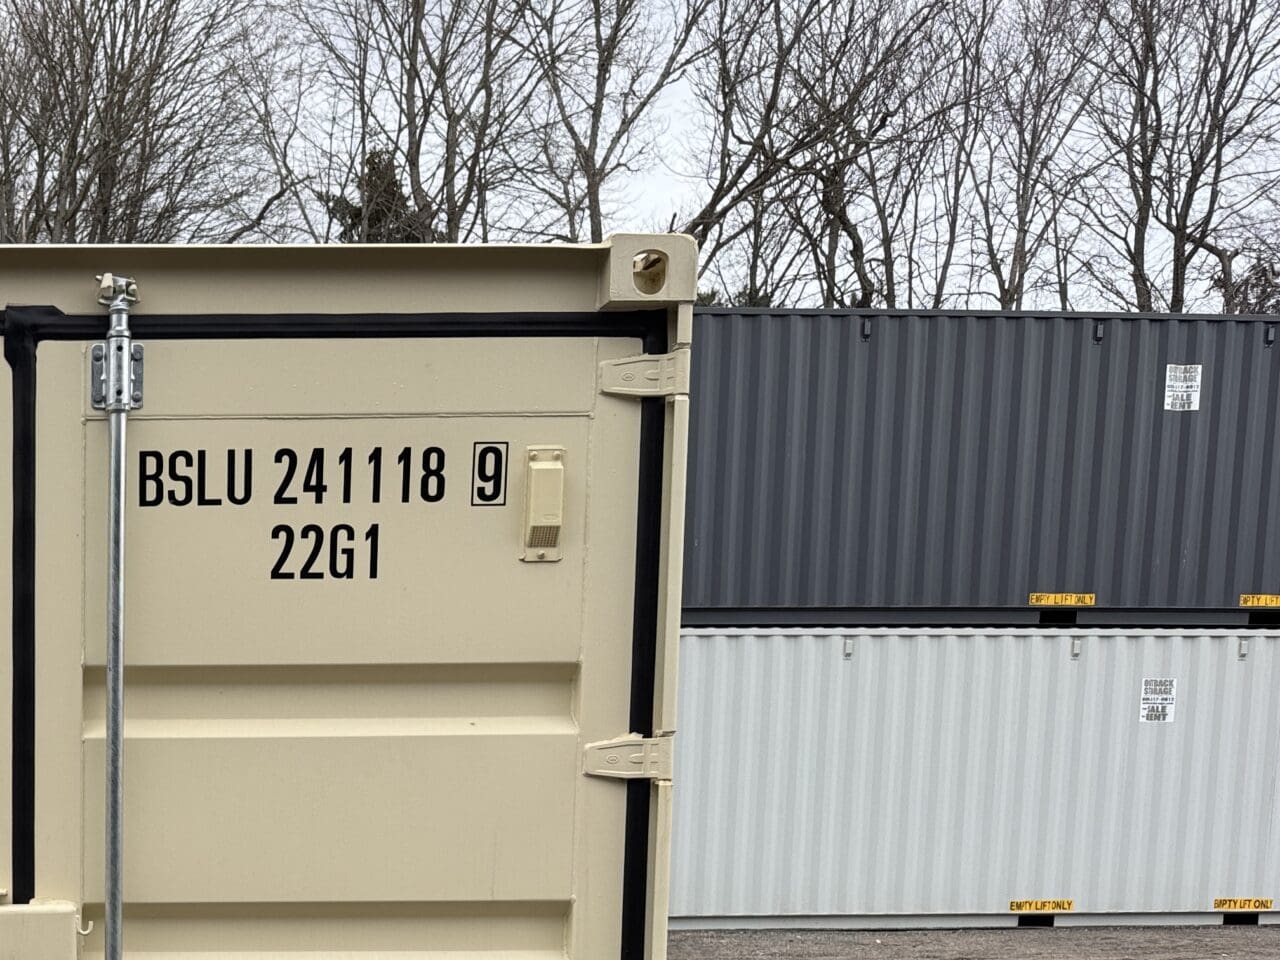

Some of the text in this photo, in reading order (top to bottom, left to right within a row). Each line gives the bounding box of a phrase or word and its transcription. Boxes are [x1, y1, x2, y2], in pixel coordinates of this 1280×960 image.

[138, 444, 505, 507] BSLU 241118 9
[270, 523, 380, 579] 22G1
[1052, 901, 1072, 910] ONLY
